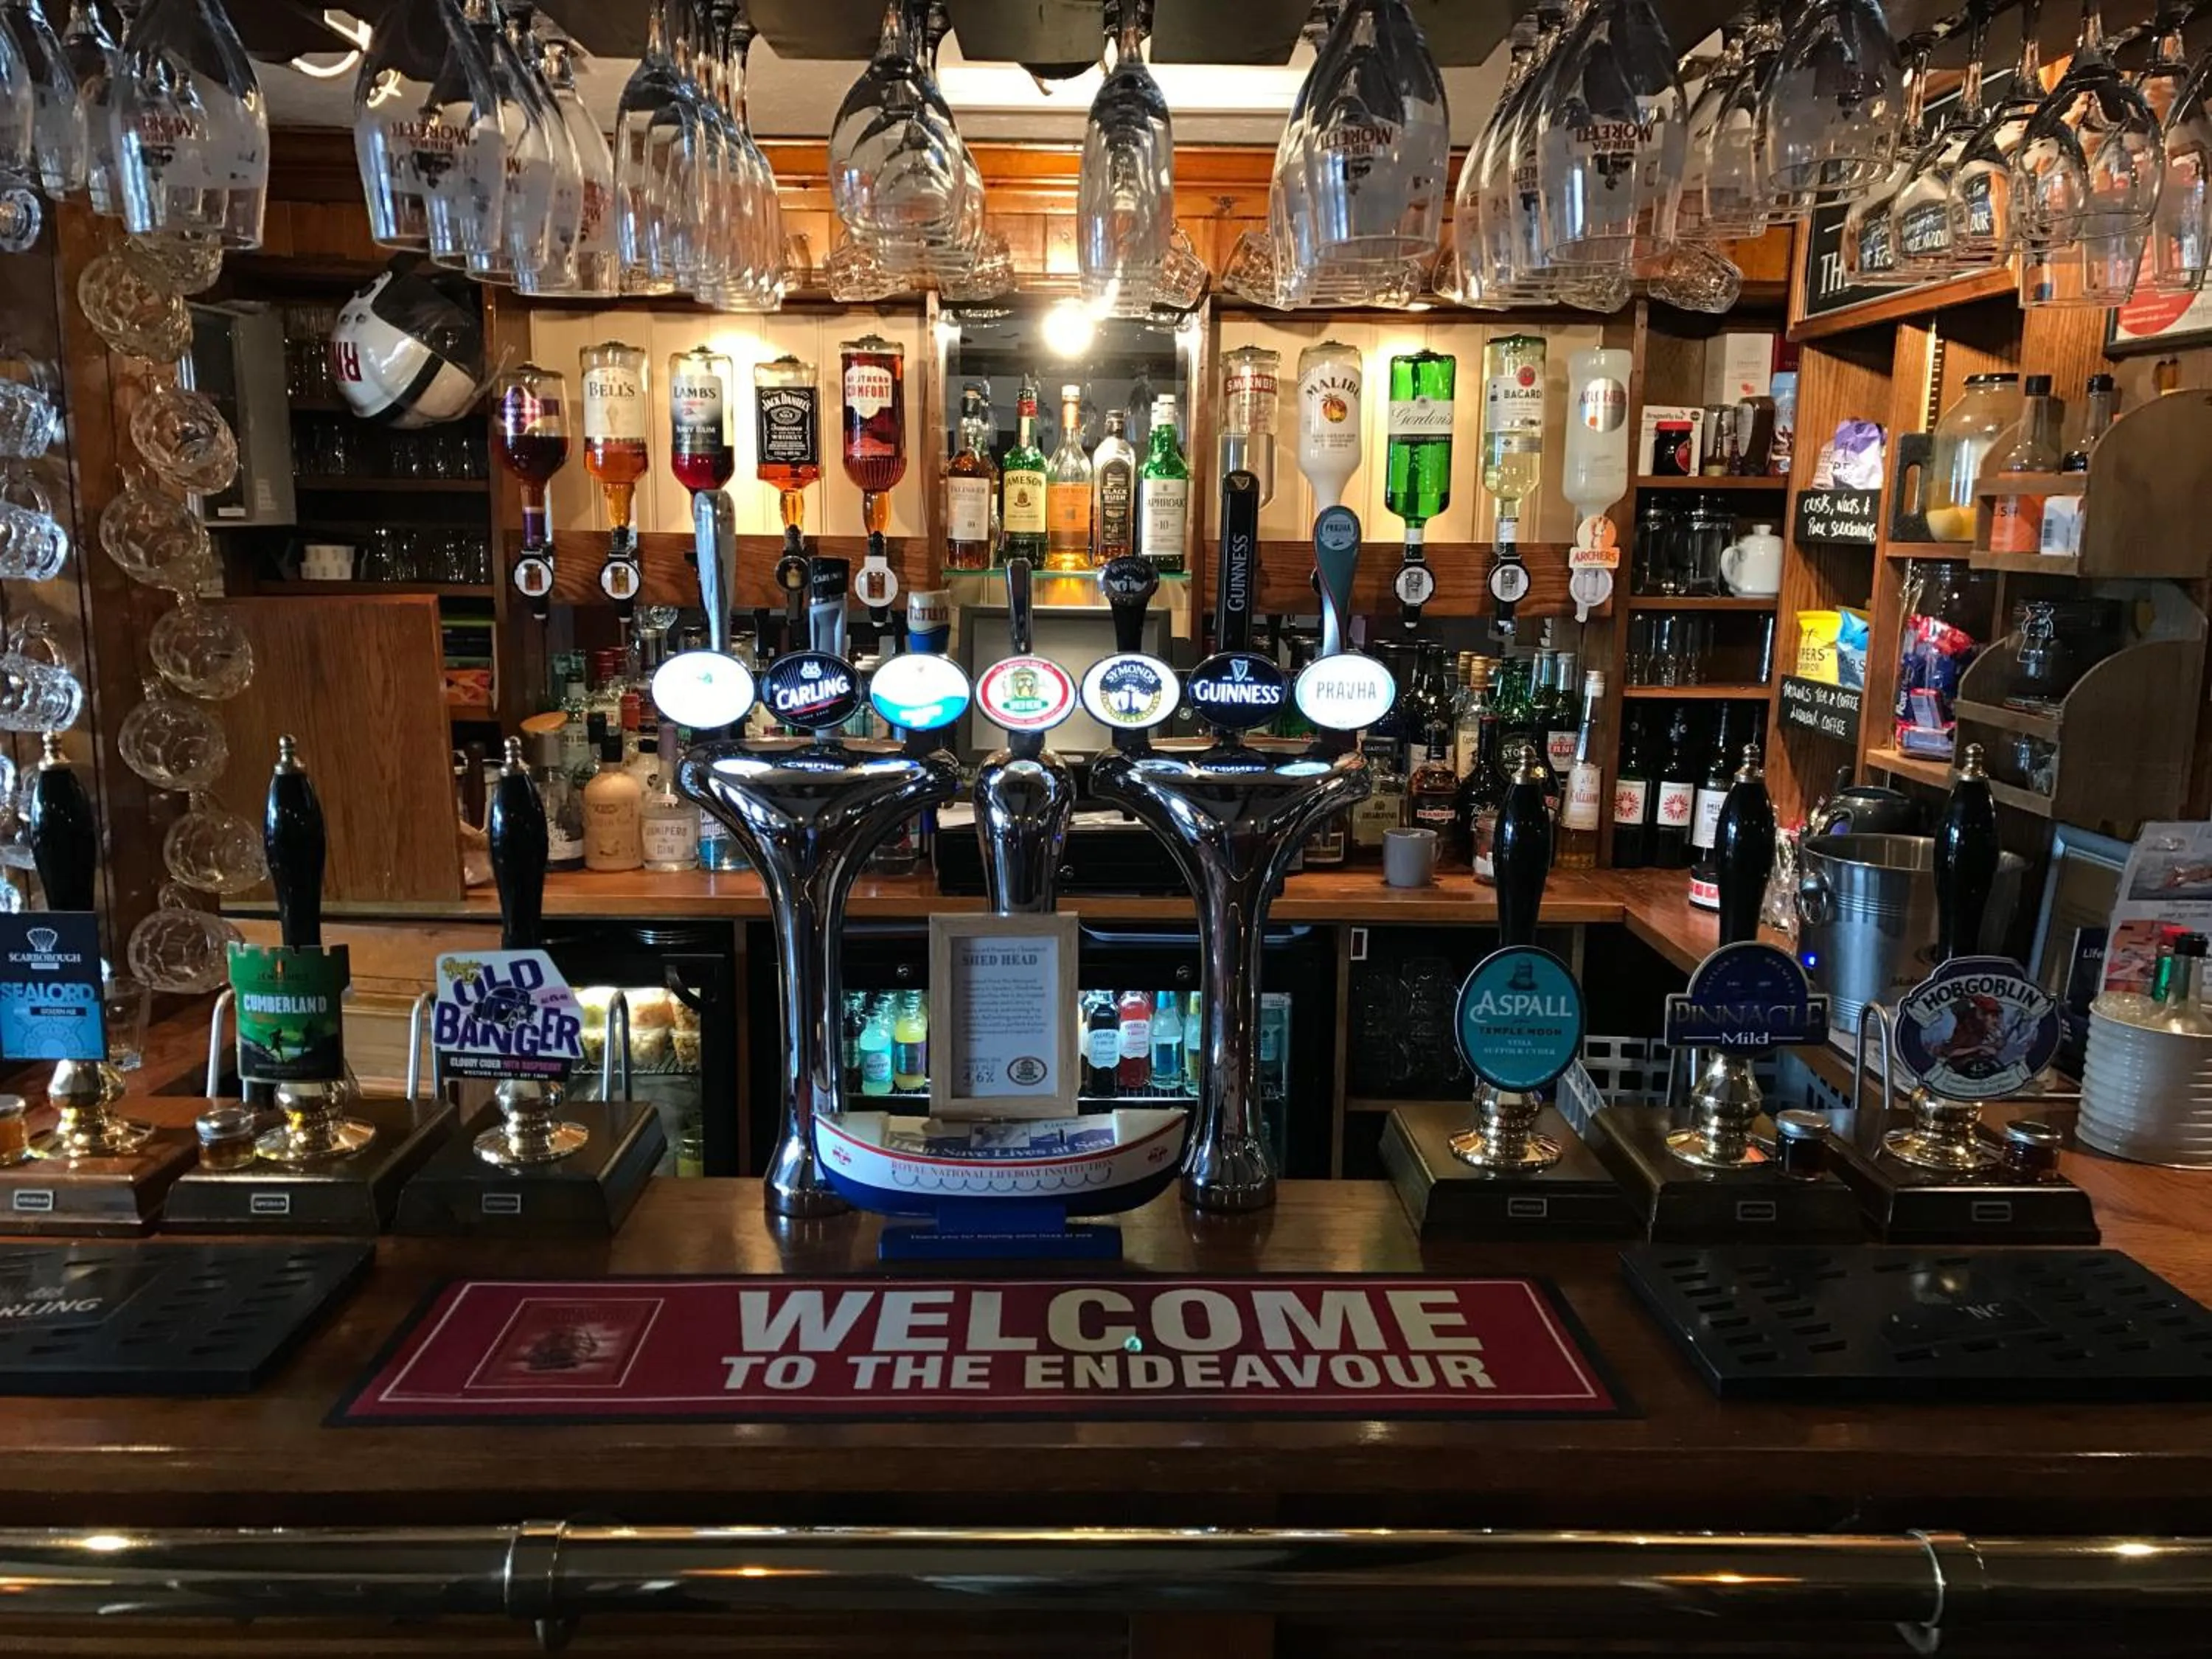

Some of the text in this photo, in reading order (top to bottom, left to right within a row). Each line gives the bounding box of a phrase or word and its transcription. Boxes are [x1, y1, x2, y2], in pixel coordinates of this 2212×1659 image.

[1576, 124, 1653, 143] MORETTI
[1574, 551, 1617, 562] ARCHERS
[1227, 533, 1249, 612] GUINNESS
[1105, 664, 1156, 684] SYMONDS
[775, 675, 849, 710] CARLING
[1194, 679, 1281, 704] GUINNESS
[1316, 681, 1377, 700] PRAVHA
[8, 951, 81, 962] SCARBOROUGH
[962, 954, 1038, 966] SHED HEAD
[0, 981, 95, 1001] SEALORD
[453, 958, 544, 1006] OLD
[243, 993, 327, 1014] CUMBERLAND
[1921, 977, 2039, 1011] HOBGOBLIN
[1469, 989, 1573, 1023] ASPALL
[1674, 1001, 1823, 1026] PINNACLE
[433, 1001, 581, 1058] BANGER
[1721, 1032, 1770, 1045] Mild
[449, 1057, 479, 1068] CLOUDY
[479, 1058, 501, 1069] CIDER
[891, 1159, 1113, 1179] ROYAL NATIONAL LIFEBOAT INSTITUTION
[738, 1289, 1484, 1352] WELCOME
[721, 1354, 1498, 1390] TO THE ENDEAVOUR
